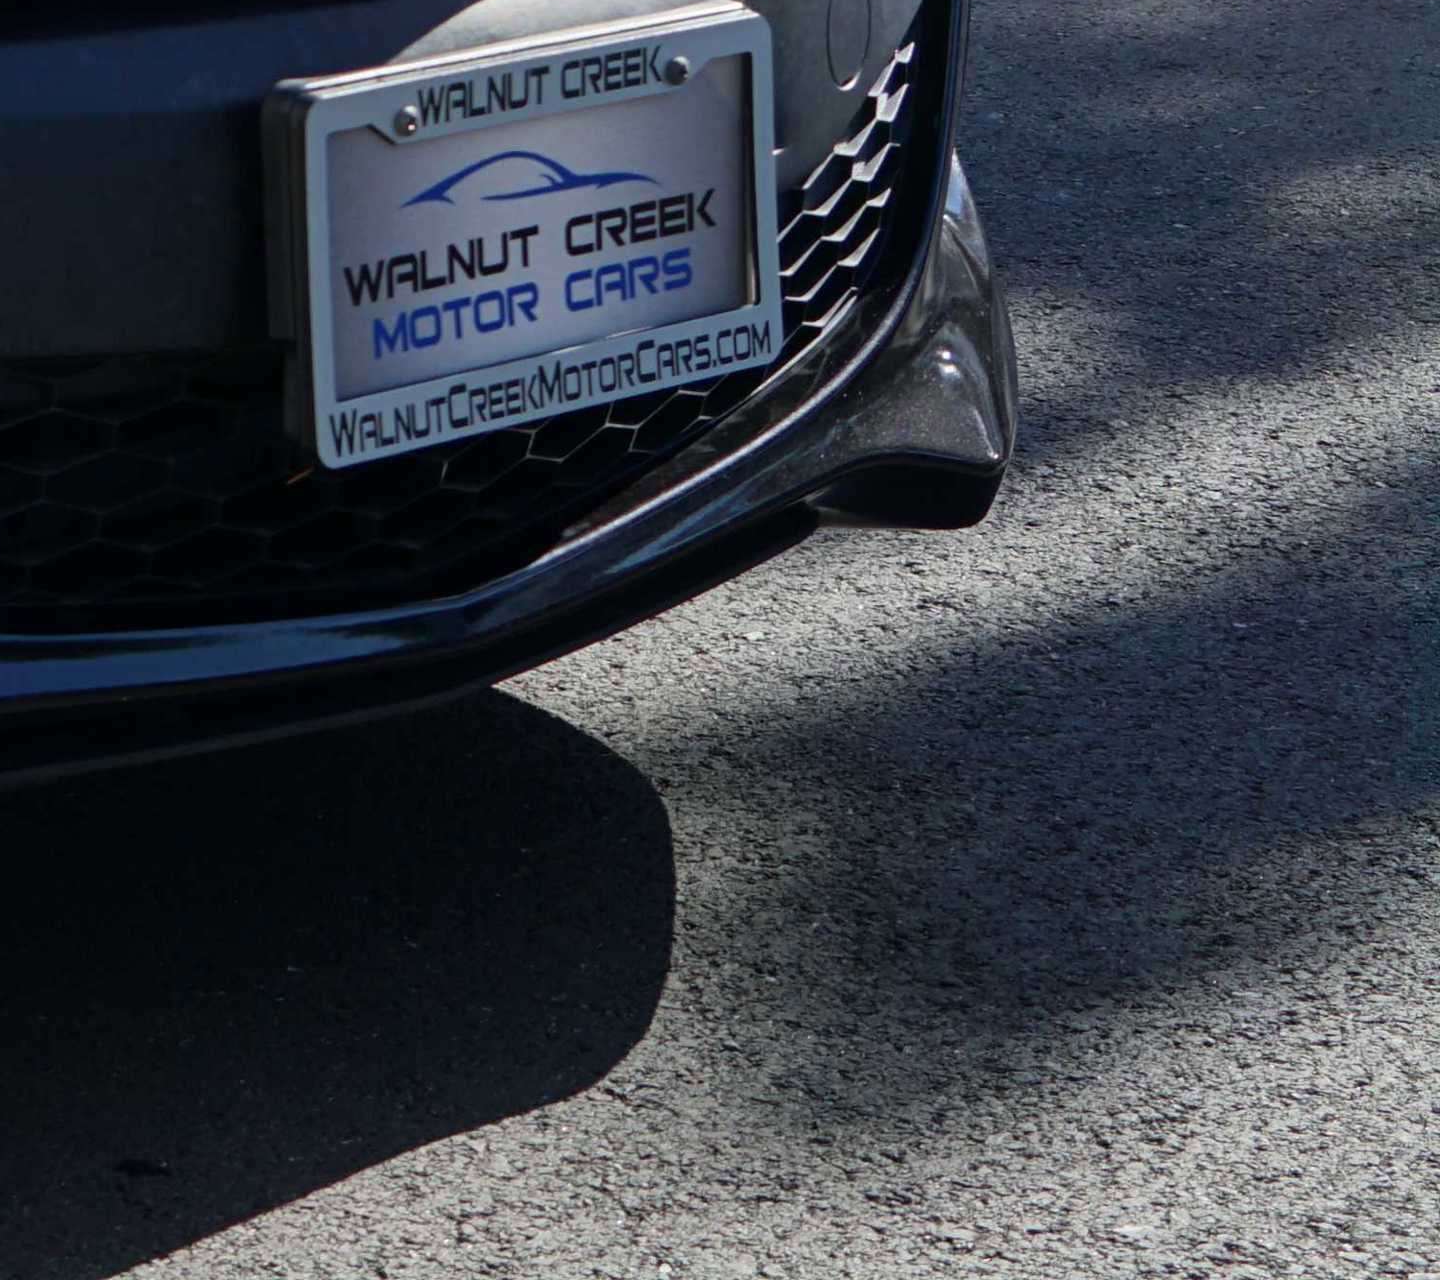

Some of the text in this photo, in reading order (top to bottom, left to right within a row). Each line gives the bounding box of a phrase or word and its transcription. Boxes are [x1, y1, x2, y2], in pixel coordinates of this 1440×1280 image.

[418, 44, 664, 127] WALNUT CREEK
[343, 187, 717, 307] WALNUT CREEK
[372, 246, 694, 359] MOTOR CARS
